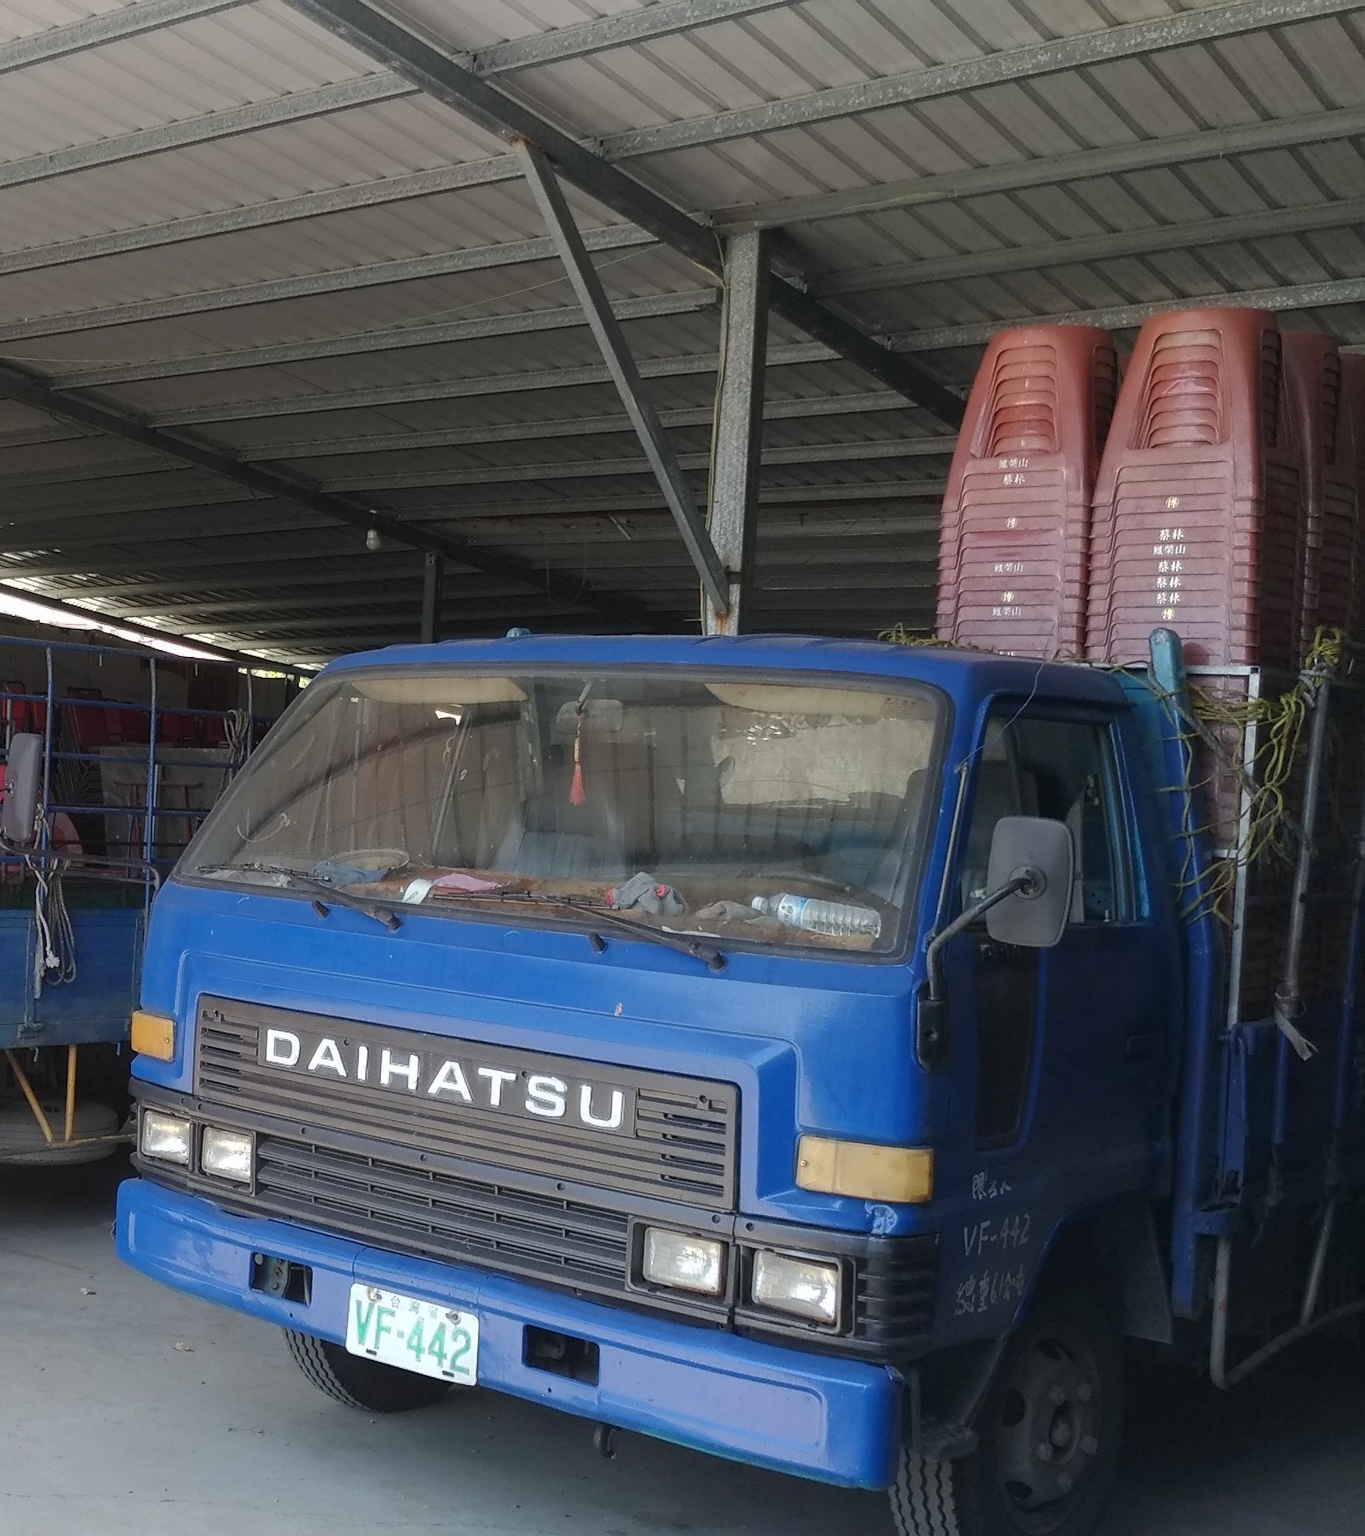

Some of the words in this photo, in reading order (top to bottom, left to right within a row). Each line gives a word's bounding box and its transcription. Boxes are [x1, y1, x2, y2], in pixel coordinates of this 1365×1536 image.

[264, 1027, 624, 1129] DAIHATSU
[963, 1213, 1031, 1257] VF-442
[354, 1299, 472, 1377] VF-442
